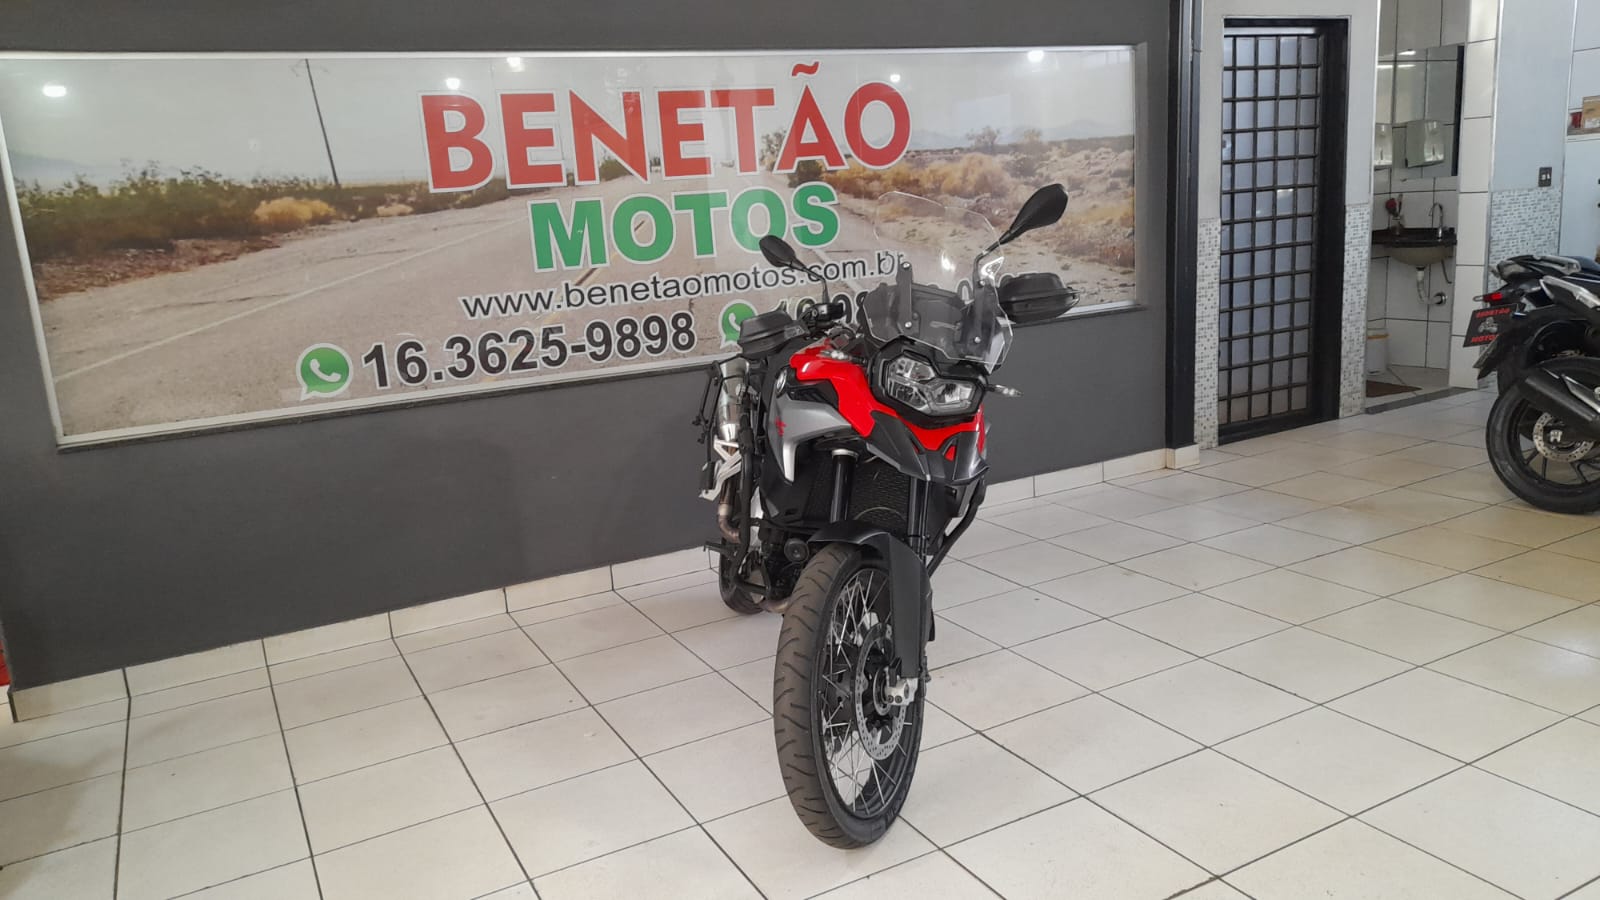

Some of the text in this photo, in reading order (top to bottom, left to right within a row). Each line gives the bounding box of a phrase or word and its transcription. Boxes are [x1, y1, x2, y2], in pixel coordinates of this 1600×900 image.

[422, 62, 911, 189] BENETÃO
[531, 184, 838, 269] MOTOS
[462, 251, 904, 318] www.benetaomotos.com.br
[363, 312, 695, 388] 16.3625-9898
